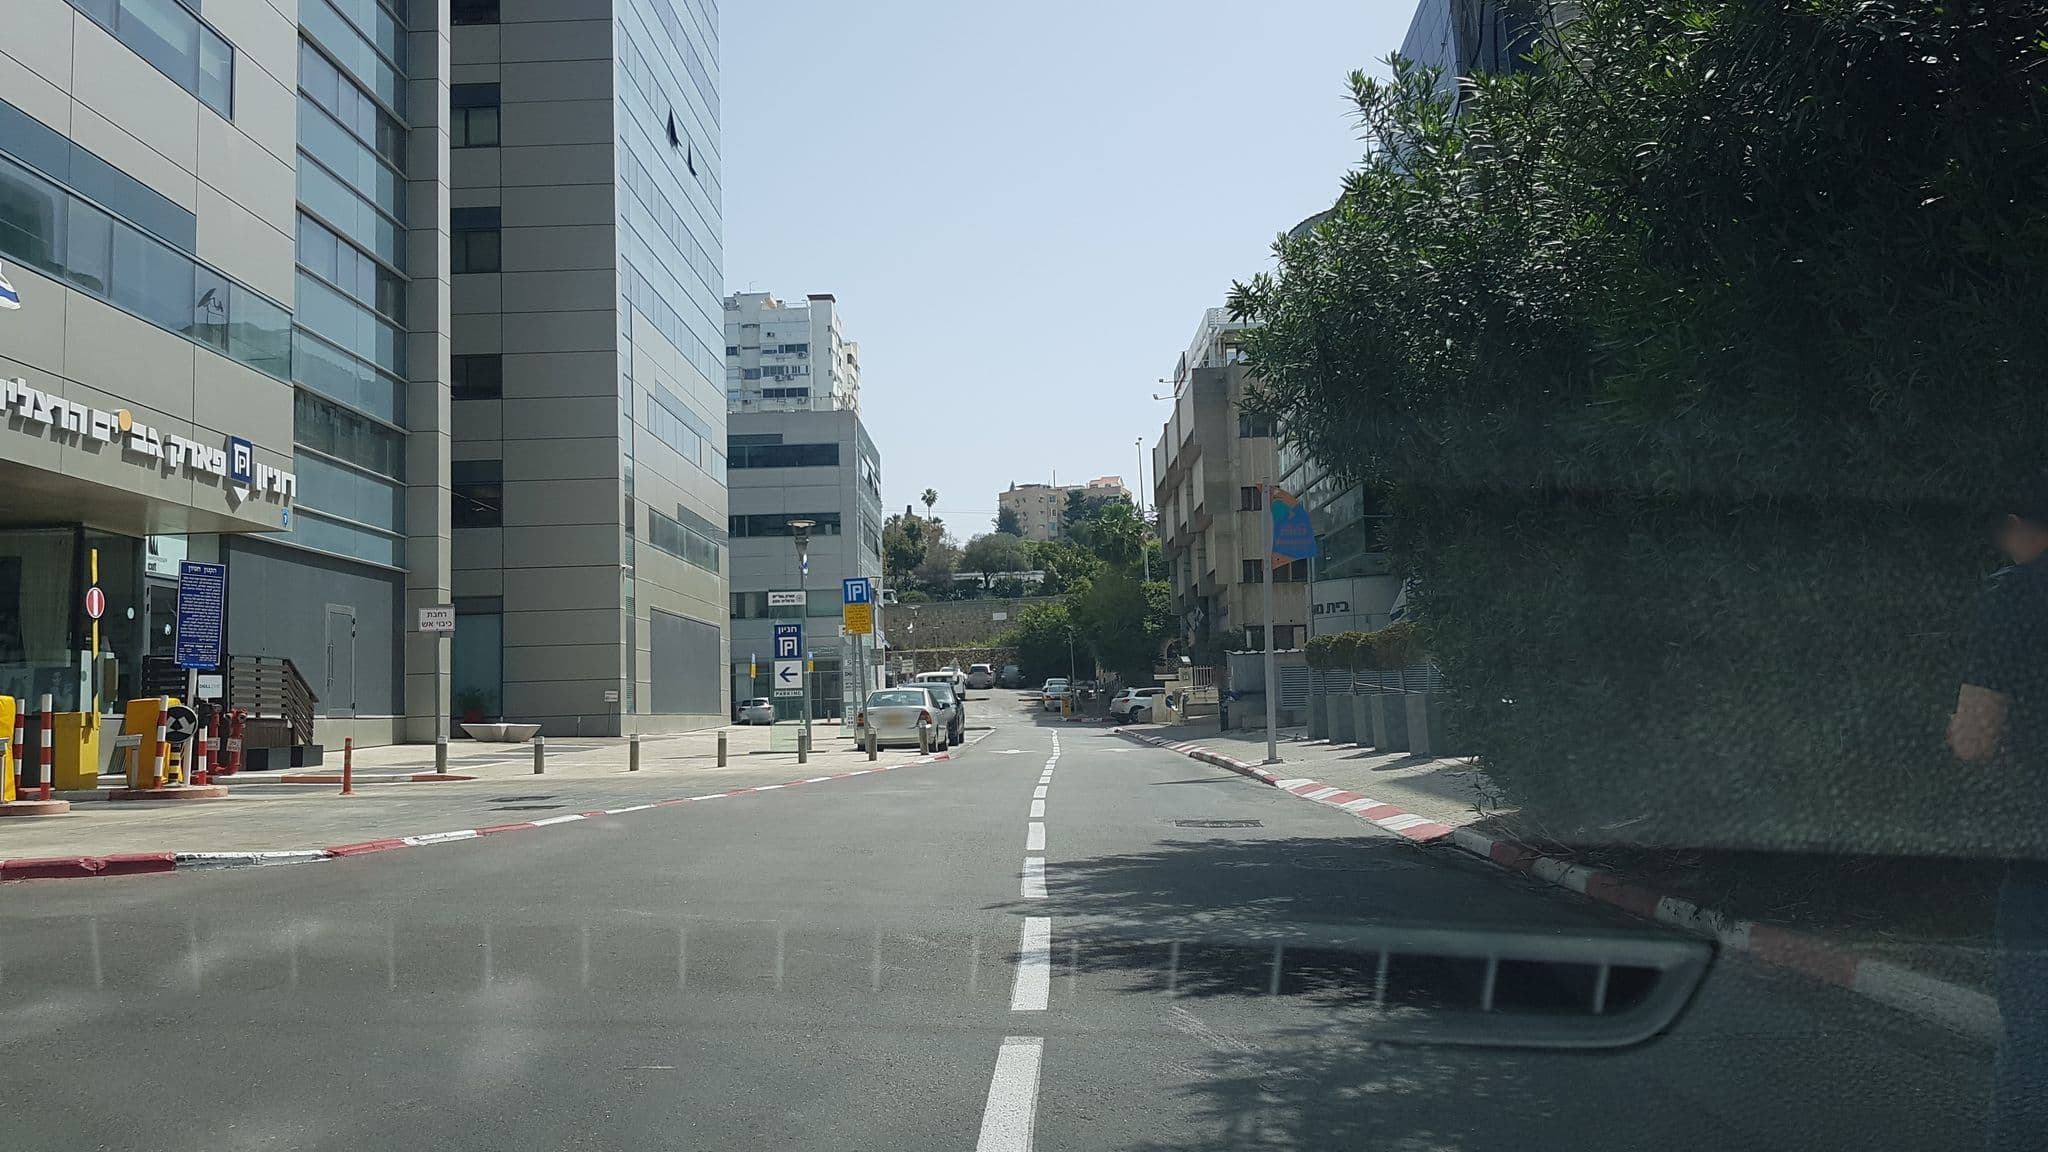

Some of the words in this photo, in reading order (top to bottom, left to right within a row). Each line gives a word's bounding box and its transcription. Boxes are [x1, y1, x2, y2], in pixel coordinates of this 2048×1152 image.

[169, 433, 227, 477] פארק
[256, 462, 297, 498] חניון
[1326, 600, 1350, 614] בית
[421, 620, 434, 628] אש
[778, 626, 797, 635] חניון
